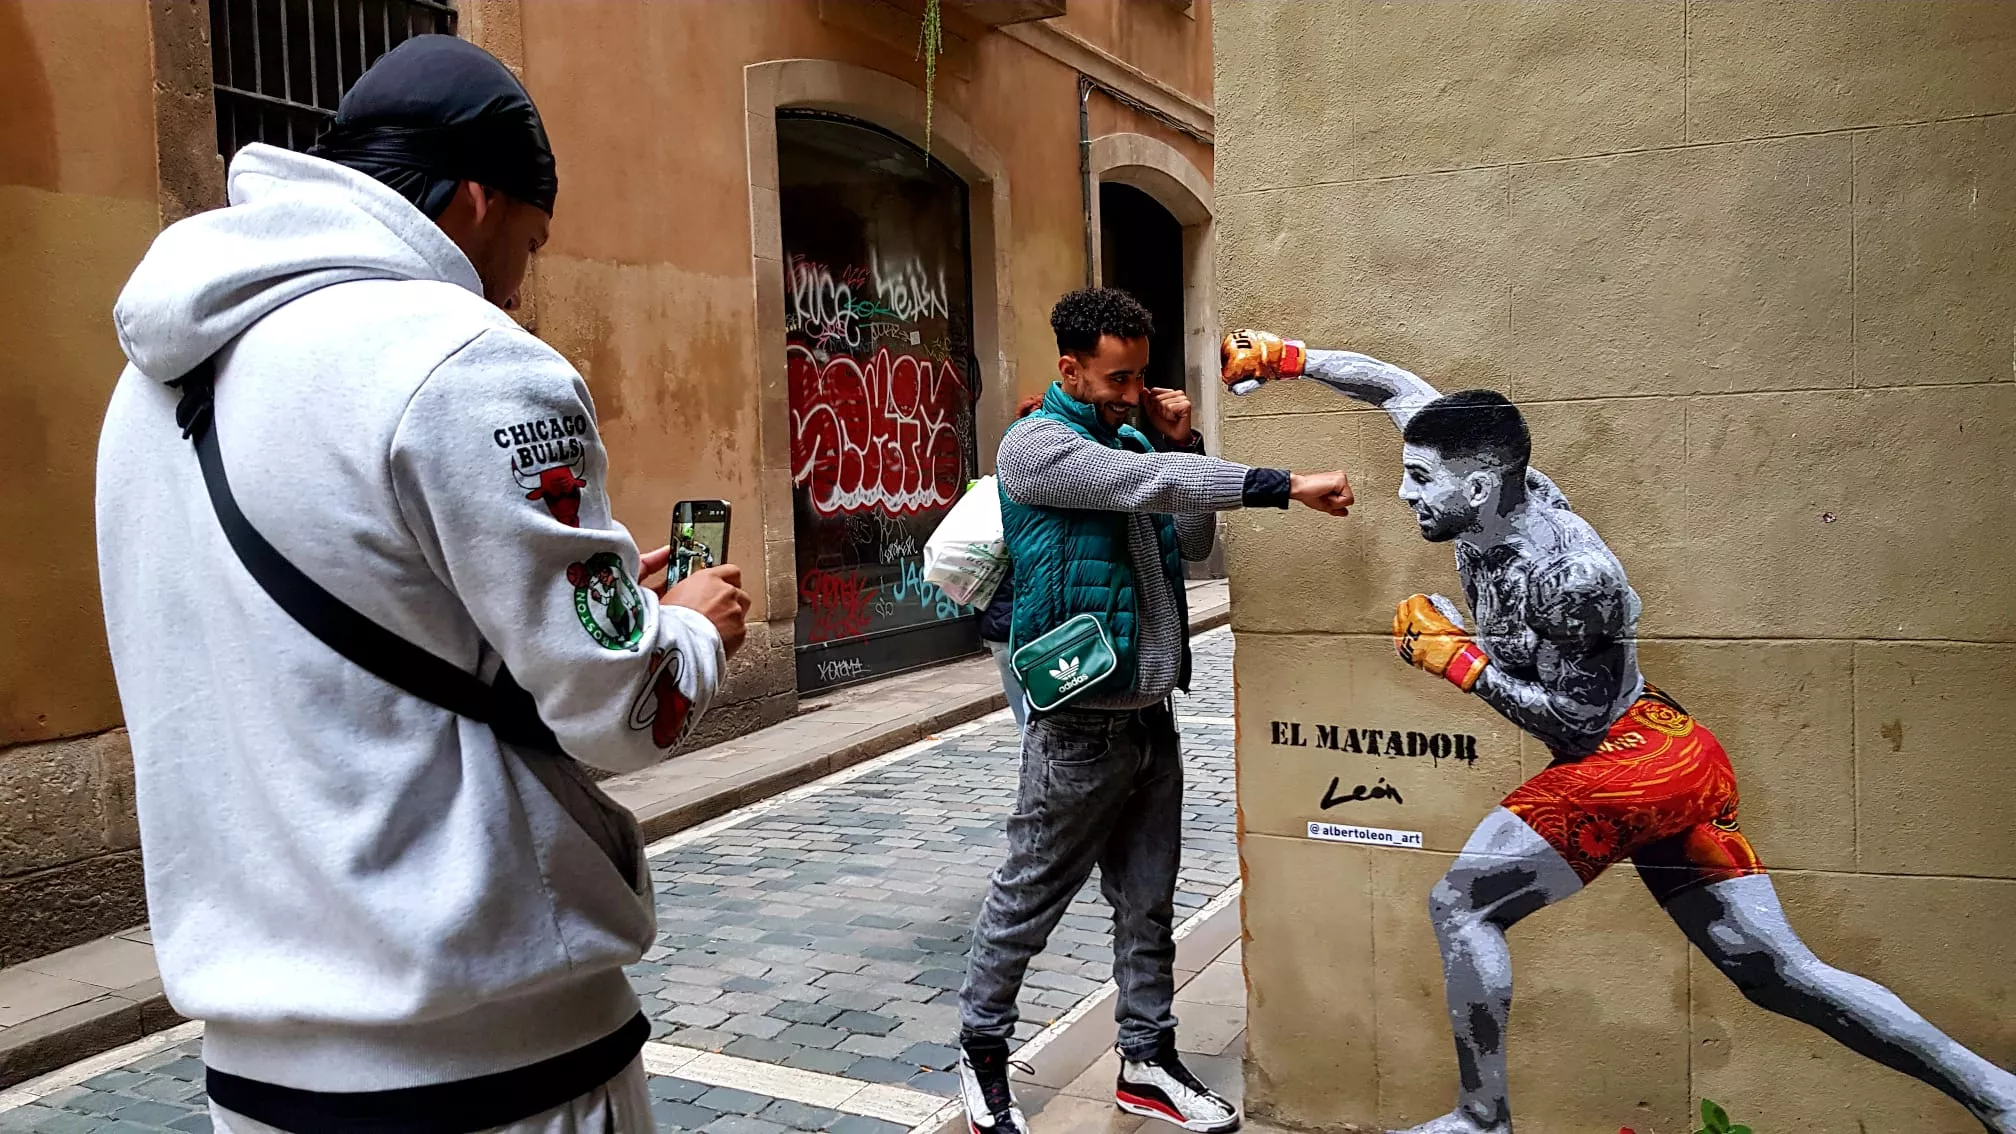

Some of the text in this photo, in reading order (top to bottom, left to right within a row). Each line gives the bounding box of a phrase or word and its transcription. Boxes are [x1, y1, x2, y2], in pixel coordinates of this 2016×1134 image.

[494, 414, 588, 449] CHICAGO
[516, 440, 582, 469] BULLS
[576, 591, 610, 648] BOSTON
[1399, 621, 1423, 667] UFC
[1059, 673, 1089, 694] adidas
[1270, 720, 1479, 761] EL MATADOR
[1319, 776, 1404, 811] León
